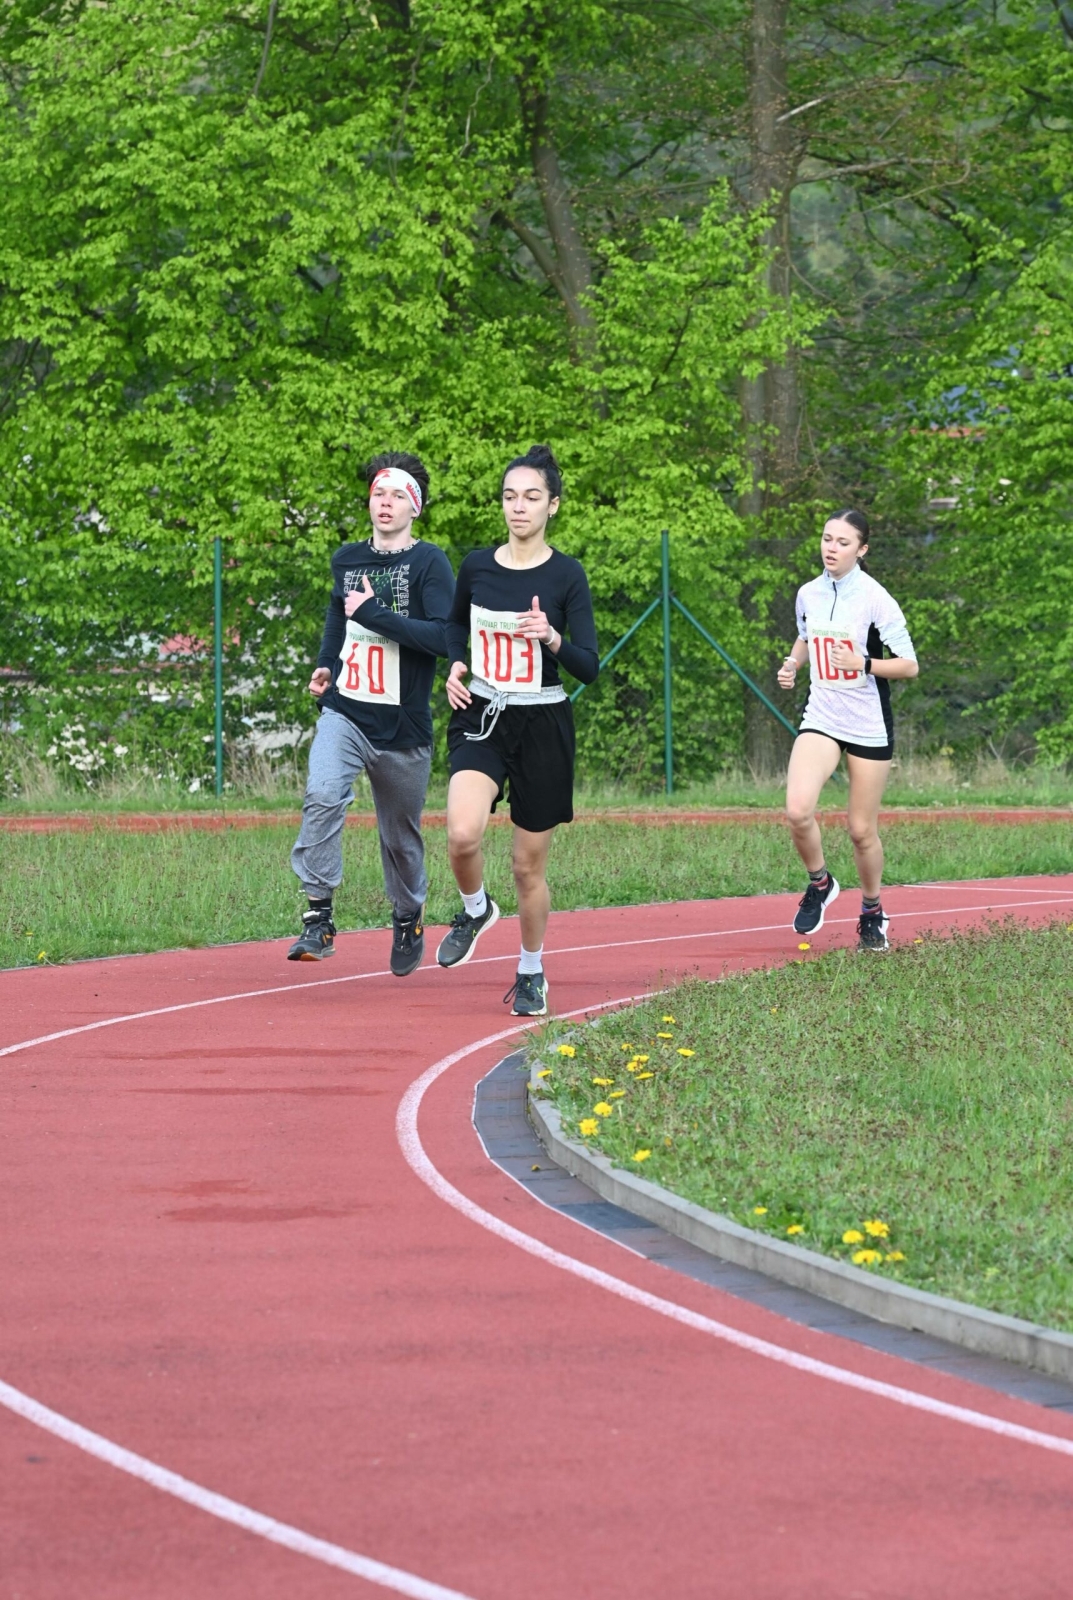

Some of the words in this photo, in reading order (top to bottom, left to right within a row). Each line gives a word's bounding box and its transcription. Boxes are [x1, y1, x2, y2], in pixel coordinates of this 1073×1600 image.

[400, 564, 410, 606] PLAYER
[366, 635, 389, 645] TRUTNOV
[476, 616, 498, 629] PIVOVAR
[346, 642, 385, 694] 60
[479, 630, 533, 683] 103
